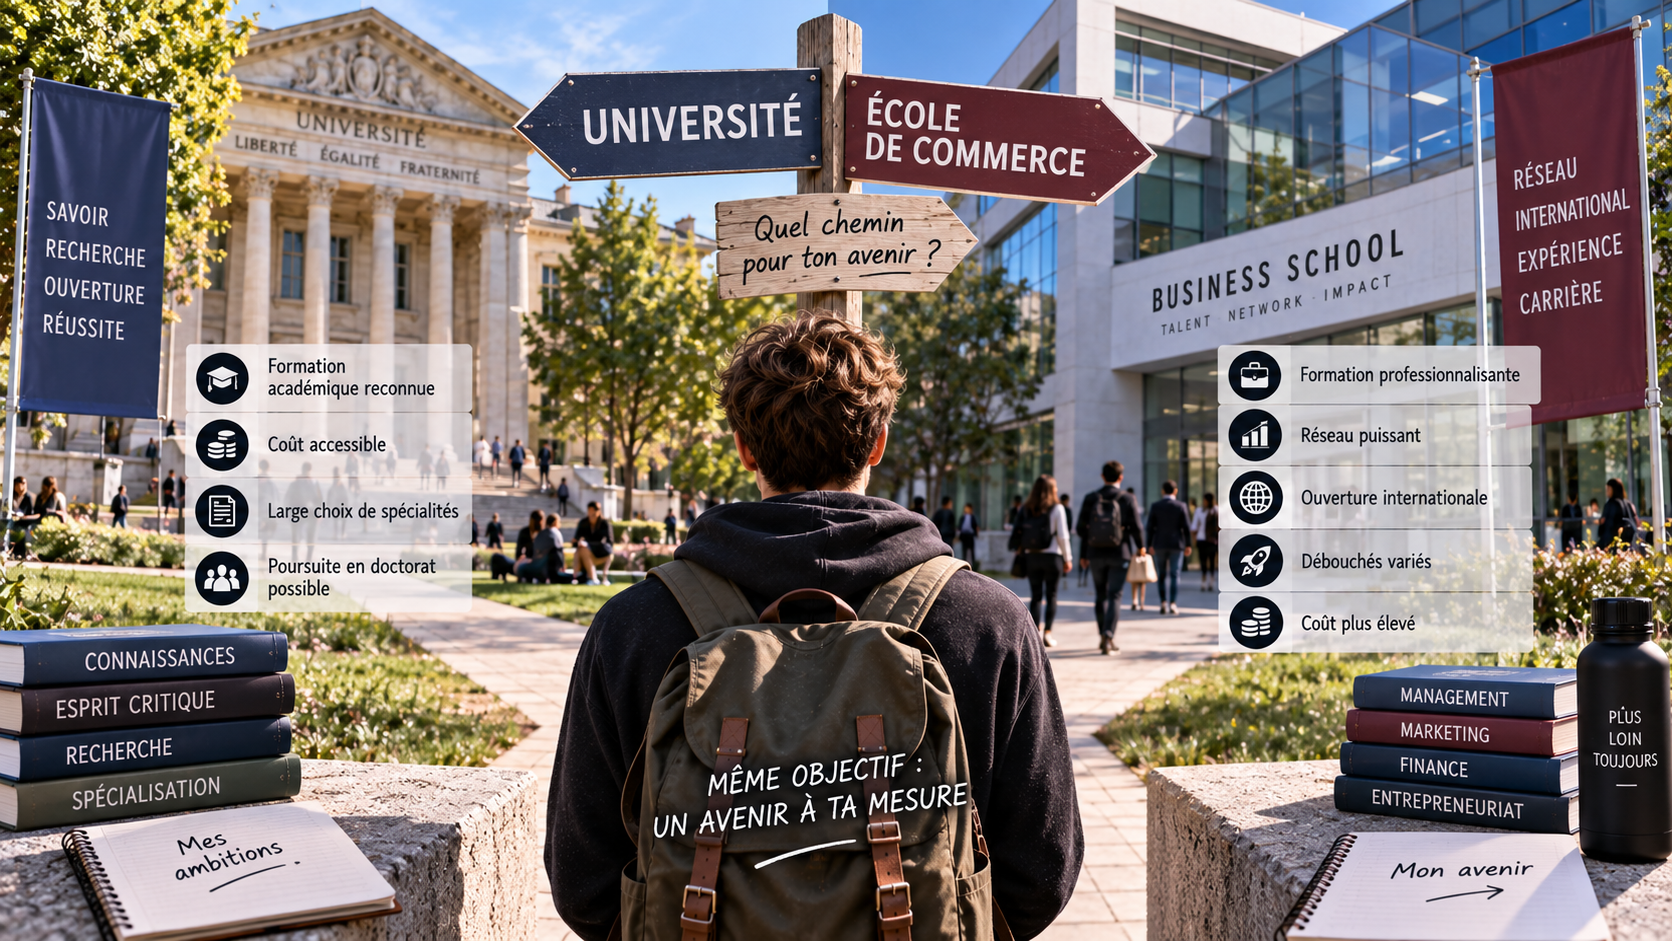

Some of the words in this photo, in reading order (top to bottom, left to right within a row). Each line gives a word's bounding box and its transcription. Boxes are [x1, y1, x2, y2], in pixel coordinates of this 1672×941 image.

[584, 93, 802, 144] UNIVERSITÉ
[868, 91, 961, 132] ÉCOLE
[297, 112, 426, 148] UNIVERSITÉ
[236, 135, 296, 157] LIBERTÉ
[321, 145, 379, 169] ÉGALITÉ
[401, 161, 479, 185] FRATERNITÉ
[866, 132, 902, 162] DE
[914, 136, 1085, 176] COMMERCE
[1514, 157, 1576, 190] RÉSEAU
[47, 201, 108, 226] SAVOIR
[1516, 188, 1630, 231] INTERNATIONAL
[755, 212, 809, 242] Quel
[822, 209, 903, 235] chemin
[46, 239, 145, 267] RECHERCHE
[742, 254, 793, 285] pour
[802, 246, 836, 268] ton
[848, 243, 916, 264] avenir
[1519, 233, 1622, 272] EXPÉRIENCE
[1152, 261, 1270, 312] BUSINESS
[1287, 229, 1403, 281] SCHOOL
[45, 276, 144, 304] OUVERTURE
[1161, 315, 1210, 335] TALENT
[1229, 295, 1302, 321] NETWORK
[1325, 274, 1390, 301] IMPACT
[1520, 280, 1602, 314] CARRIÈRE
[44, 314, 124, 340] RÉUSSITE
[85, 647, 234, 671] CONNAISSANCES
[57, 697, 120, 719] ESPRIT
[130, 691, 214, 713] CRITIQUE
[1401, 687, 1509, 707] MANAGEMENT
[1401, 722, 1489, 742] MARKETING
[1610, 732, 1641, 745] LOIN
[67, 738, 172, 765] RECHERCHE
[1401, 757, 1468, 777] FINANCE
[1593, 753, 1657, 768] TOUJOURS
[73, 776, 219, 810] SPÉCIALISATION
[1373, 789, 1524, 819] ENTREPRENEURIAT
[177, 832, 227, 856] Mes
[175, 839, 283, 881] ambitions
[1391, 863, 1443, 879] Mon
[1459, 861, 1533, 876] avenir
